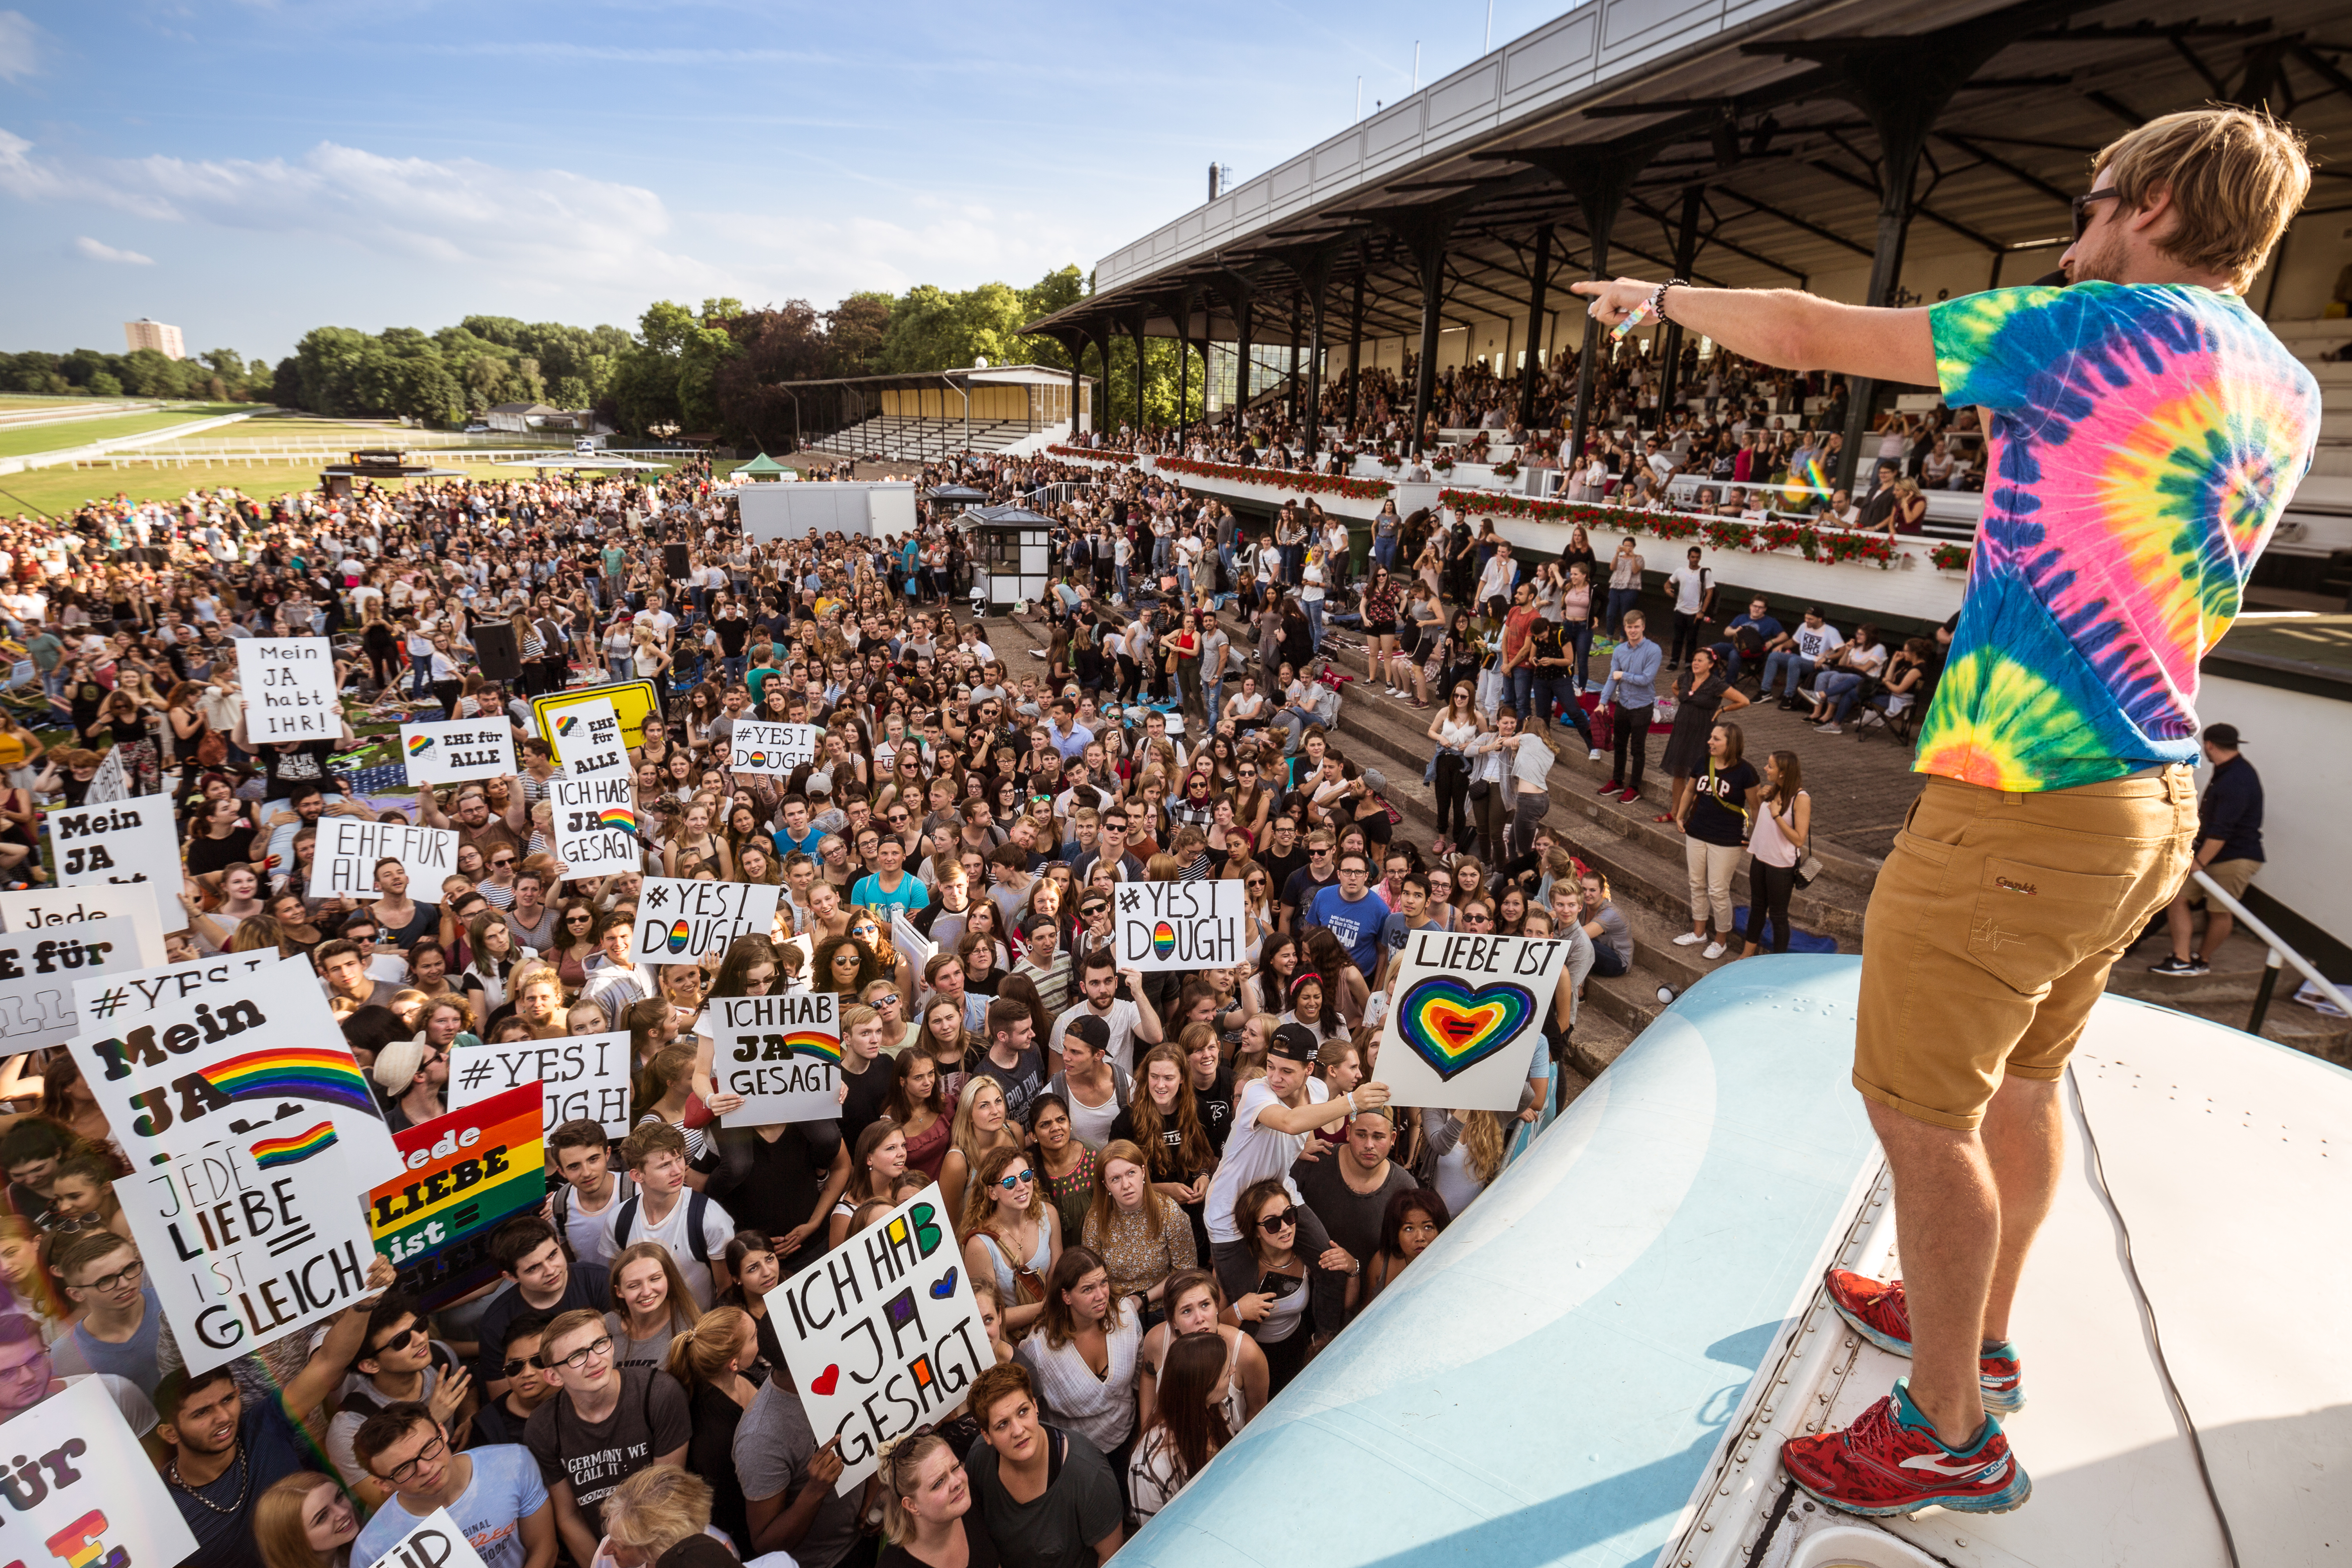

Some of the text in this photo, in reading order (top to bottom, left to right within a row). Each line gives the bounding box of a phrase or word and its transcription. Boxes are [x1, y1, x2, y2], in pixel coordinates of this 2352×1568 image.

[260, 645, 317, 660] Mein
[263, 668, 298, 686] JA
[265, 690, 323, 707] habt
[268, 713, 326, 733] IHR!
[444, 730, 503, 746] EHE für
[588, 718, 615, 732] EHE
[592, 732, 614, 745] für
[736, 726, 807, 745] #YES I
[449, 749, 501, 768] ALLE
[575, 751, 619, 775] ALLE
[558, 778, 629, 806] ICH HAB
[58, 809, 142, 840] Mein
[568, 810, 603, 833] JA
[65, 845, 115, 875] JA
[338, 824, 449, 868] EHE FÜR
[563, 831, 635, 862] GESAGT
[646, 883, 750, 920] #YES I
[1119, 881, 1218, 919] #YES I
[26, 904, 108, 929] Jede
[1127, 917, 1235, 962] DOUGH
[33, 939, 114, 973] für
[1415, 935, 1510, 972] LIEBE
[1513, 941, 1561, 976] IST
[724, 997, 832, 1028] ICH HAB
[93, 999, 267, 1082] Mein
[732, 1034, 794, 1063] JA
[459, 1042, 610, 1090] #YES I
[729, 1063, 834, 1096] GESAGT
[129, 1072, 233, 1137] JA
[148, 1146, 253, 1217] JEDE
[374, 1144, 509, 1228] LIEBE
[167, 1177, 303, 1262] LIEBE
[390, 1221, 446, 1265] ist
[192, 1251, 246, 1303] IST
[785, 1202, 942, 1341] ICH HAB
[195, 1239, 365, 1349] GLEICH
[840, 1286, 928, 1385] JA
[834, 1316, 984, 1466] GESAGT
[568, 1448, 622, 1473] GERMANY
[626, 1442, 648, 1459] WE
[1984, 1448, 2011, 1476] LAUNCH
[0, 1438, 87, 1512] ür
[575, 1465, 604, 1485] CALL
[608, 1463, 618, 1475] IT
